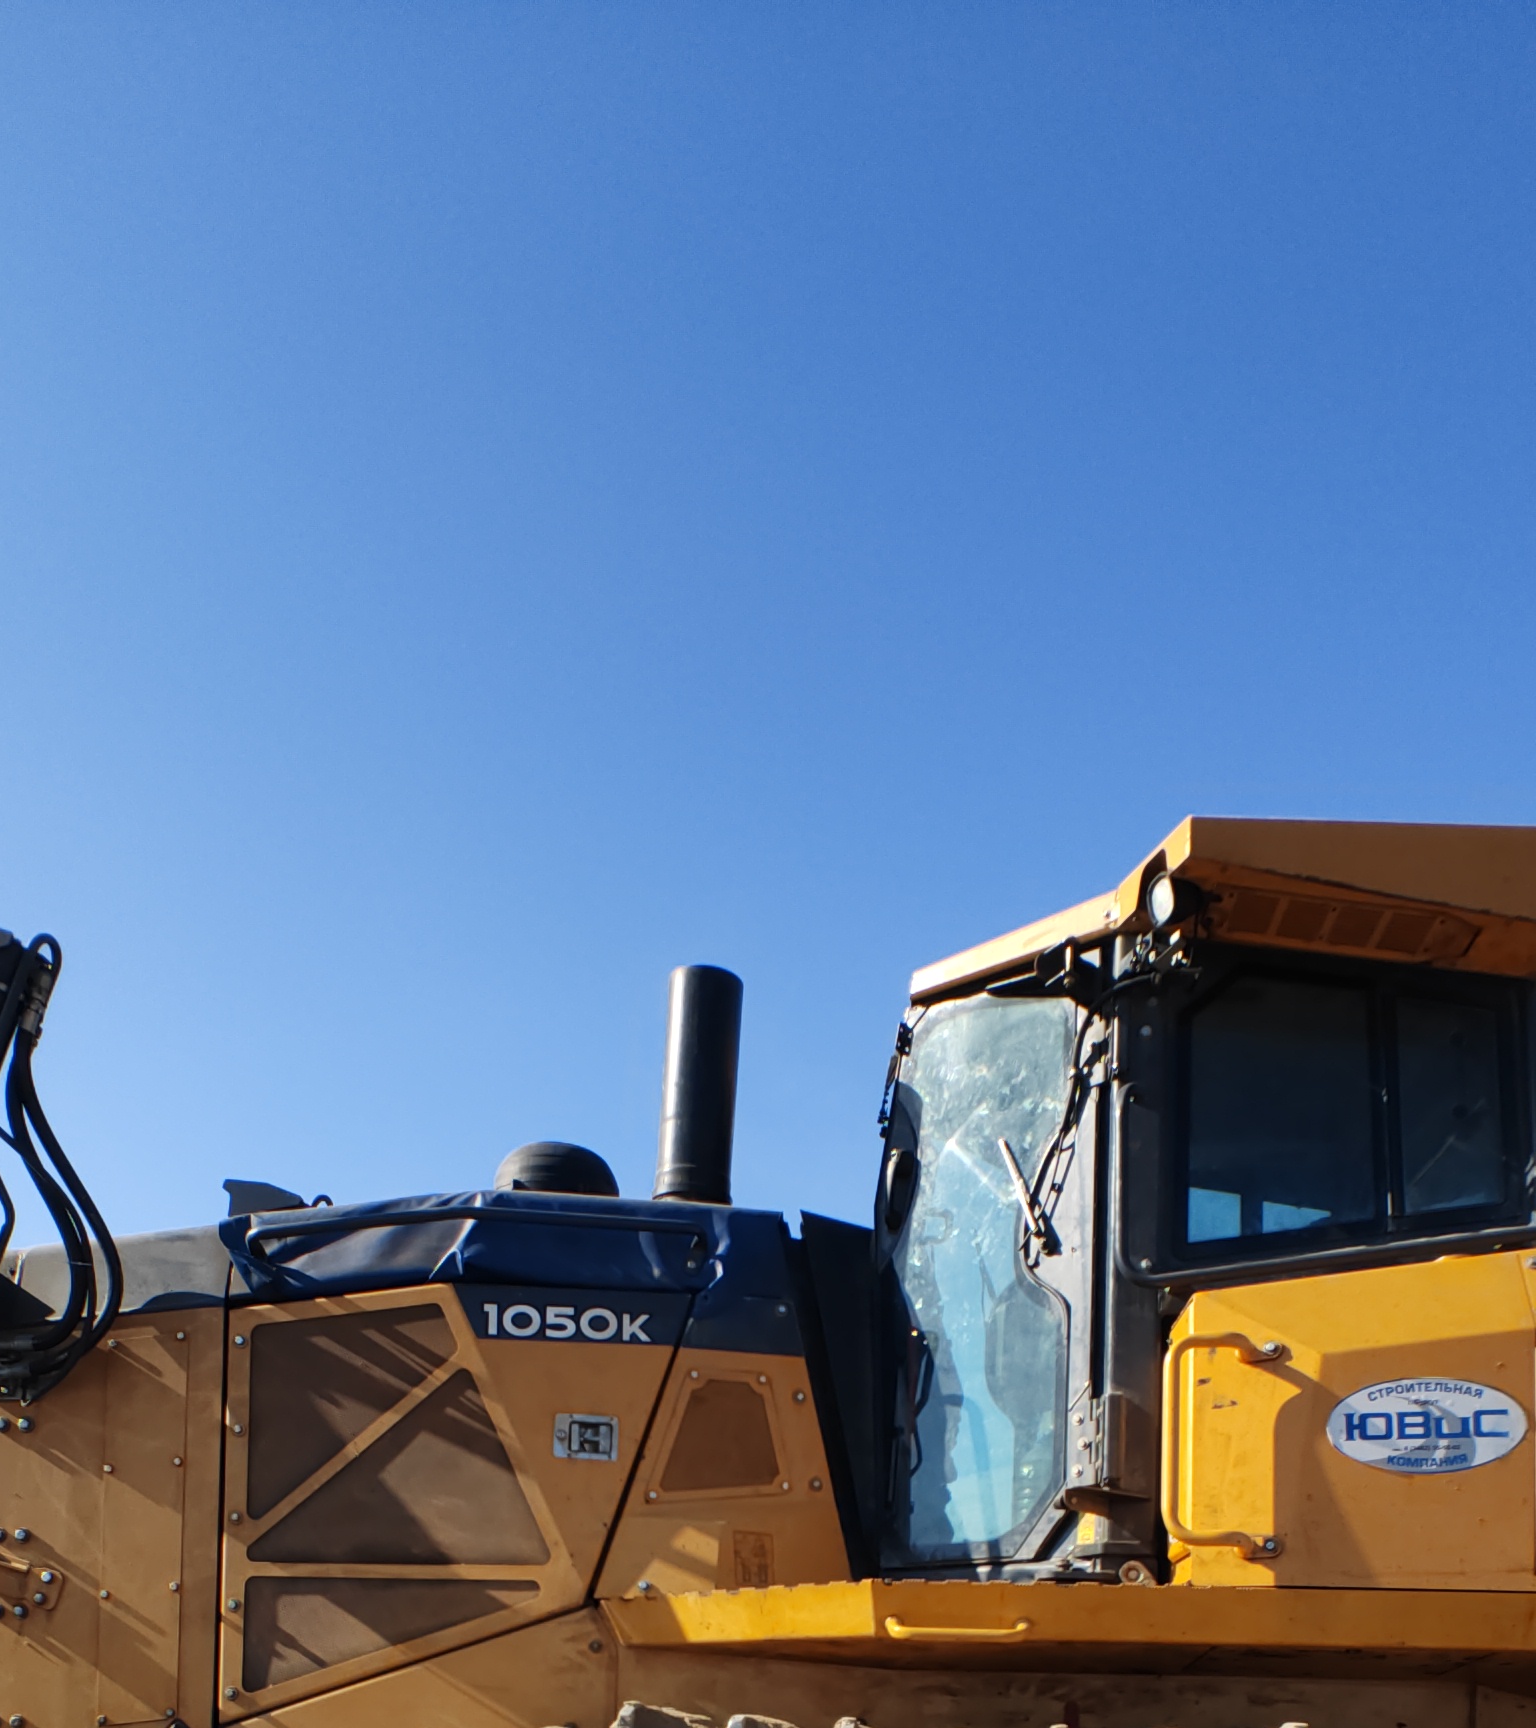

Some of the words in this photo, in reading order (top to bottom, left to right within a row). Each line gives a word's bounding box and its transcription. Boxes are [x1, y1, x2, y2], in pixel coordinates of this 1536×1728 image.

[482, 1303, 652, 1343] 1050K
[1367, 1382, 1484, 1402] СТРОИТЕЛЬНАЯ
[1386, 1453, 1469, 1468] КОМПАНИЯ
